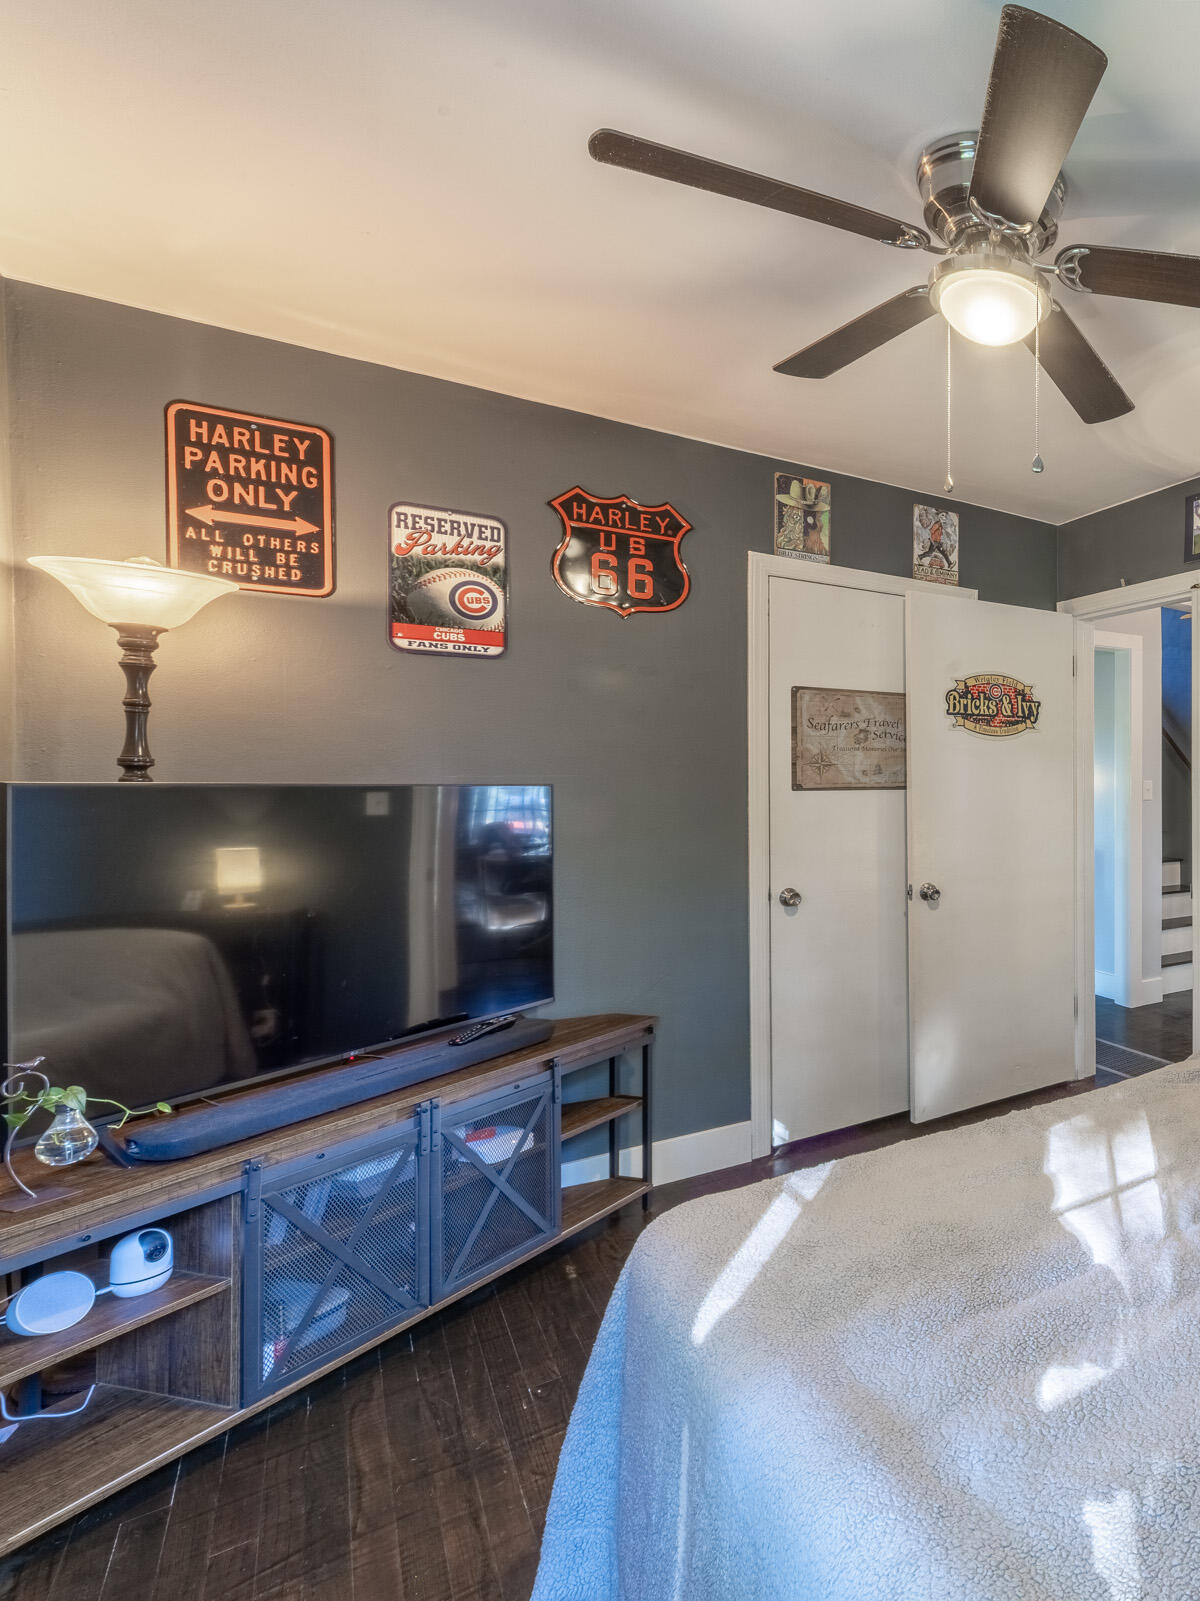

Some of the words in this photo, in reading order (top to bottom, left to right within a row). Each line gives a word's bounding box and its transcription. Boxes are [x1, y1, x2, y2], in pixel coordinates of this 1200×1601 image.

[189, 418, 311, 460] HARLEY
[184, 446, 319, 489] PARKING
[206, 478, 298, 511] ONLY
[394, 511, 502, 543] RESERVED
[573, 502, 670, 534] HARLEY
[185, 526, 225, 542] ALL
[243, 533, 320, 554] OTHERS
[209, 545, 258, 561] WILL
[276, 552, 300, 566] BE
[394, 529, 504, 565] Parking
[208, 560, 303, 581] CRUSHED
[591, 552, 653, 600] 66
[407, 641, 449, 650] FANS
[452, 643, 490, 652] ONLY
[433, 631, 466, 642] CUBS
[949, 690, 997, 715] Bricks
[1002, 694, 1013, 717] &
[1017, 695, 1039, 723] Ivy
[806, 715, 860, 736] Seafarers
[863, 717, 900, 729] Travel
